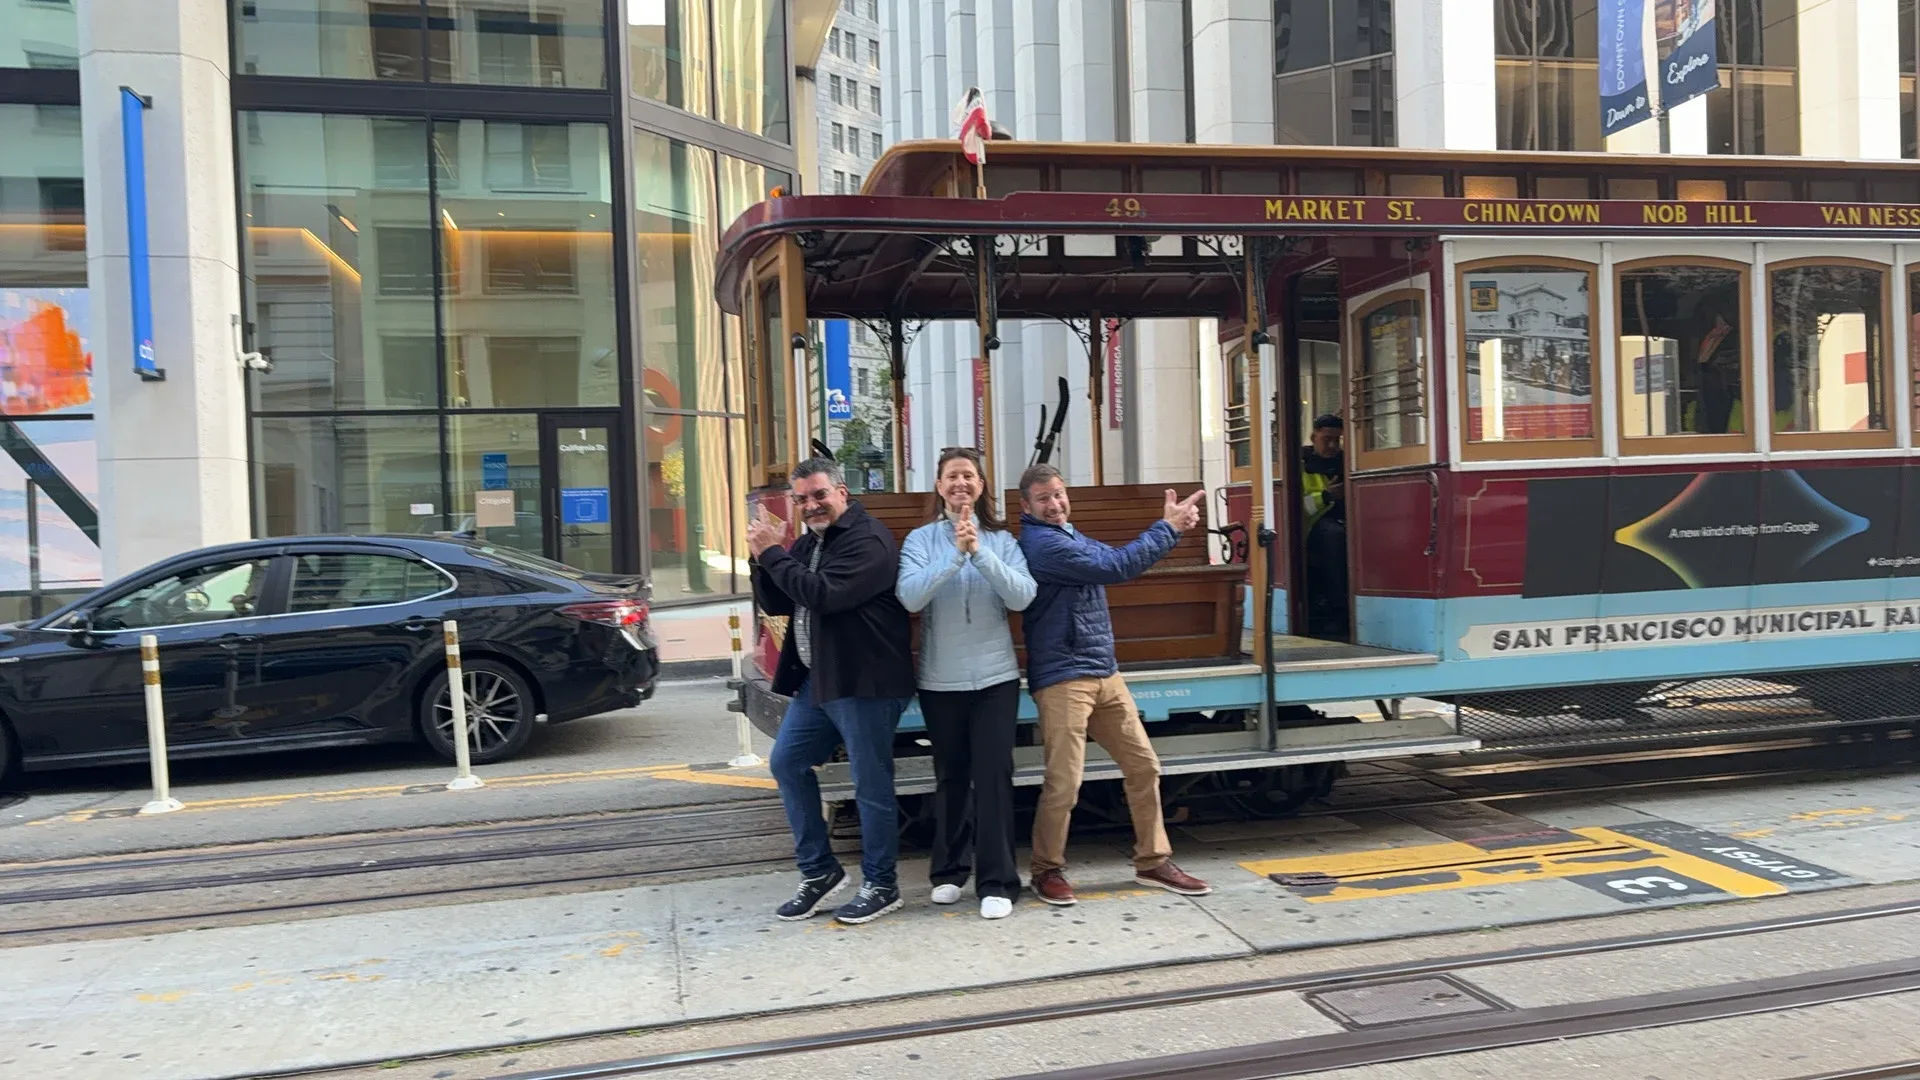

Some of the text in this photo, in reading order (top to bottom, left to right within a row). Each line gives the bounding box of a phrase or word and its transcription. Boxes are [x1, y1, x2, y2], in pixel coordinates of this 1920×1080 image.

[1616, 8, 1625, 91] DOWNTOWN
[1666, 53, 1709, 84] Explore
[1606, 104, 1635, 128] Down
[1105, 198, 1140, 218] 49
[1264, 199, 1920, 226] MARKET ST. CHINATOWN NOB HILL VAN NESS
[829, 401, 850, 414] citi
[578, 428, 587, 441] 1
[1668, 521, 1820, 539] A new kind of help from Google
[1493, 627, 1553, 651] SAN
[1564, 616, 1725, 647] FRANCISCO
[1733, 608, 1874, 636] MUNICIPAL
[1165, 689, 1192, 698] ONLY
[1701, 846, 1822, 880] GYPSY
[1605, 875, 1689, 896] 3
